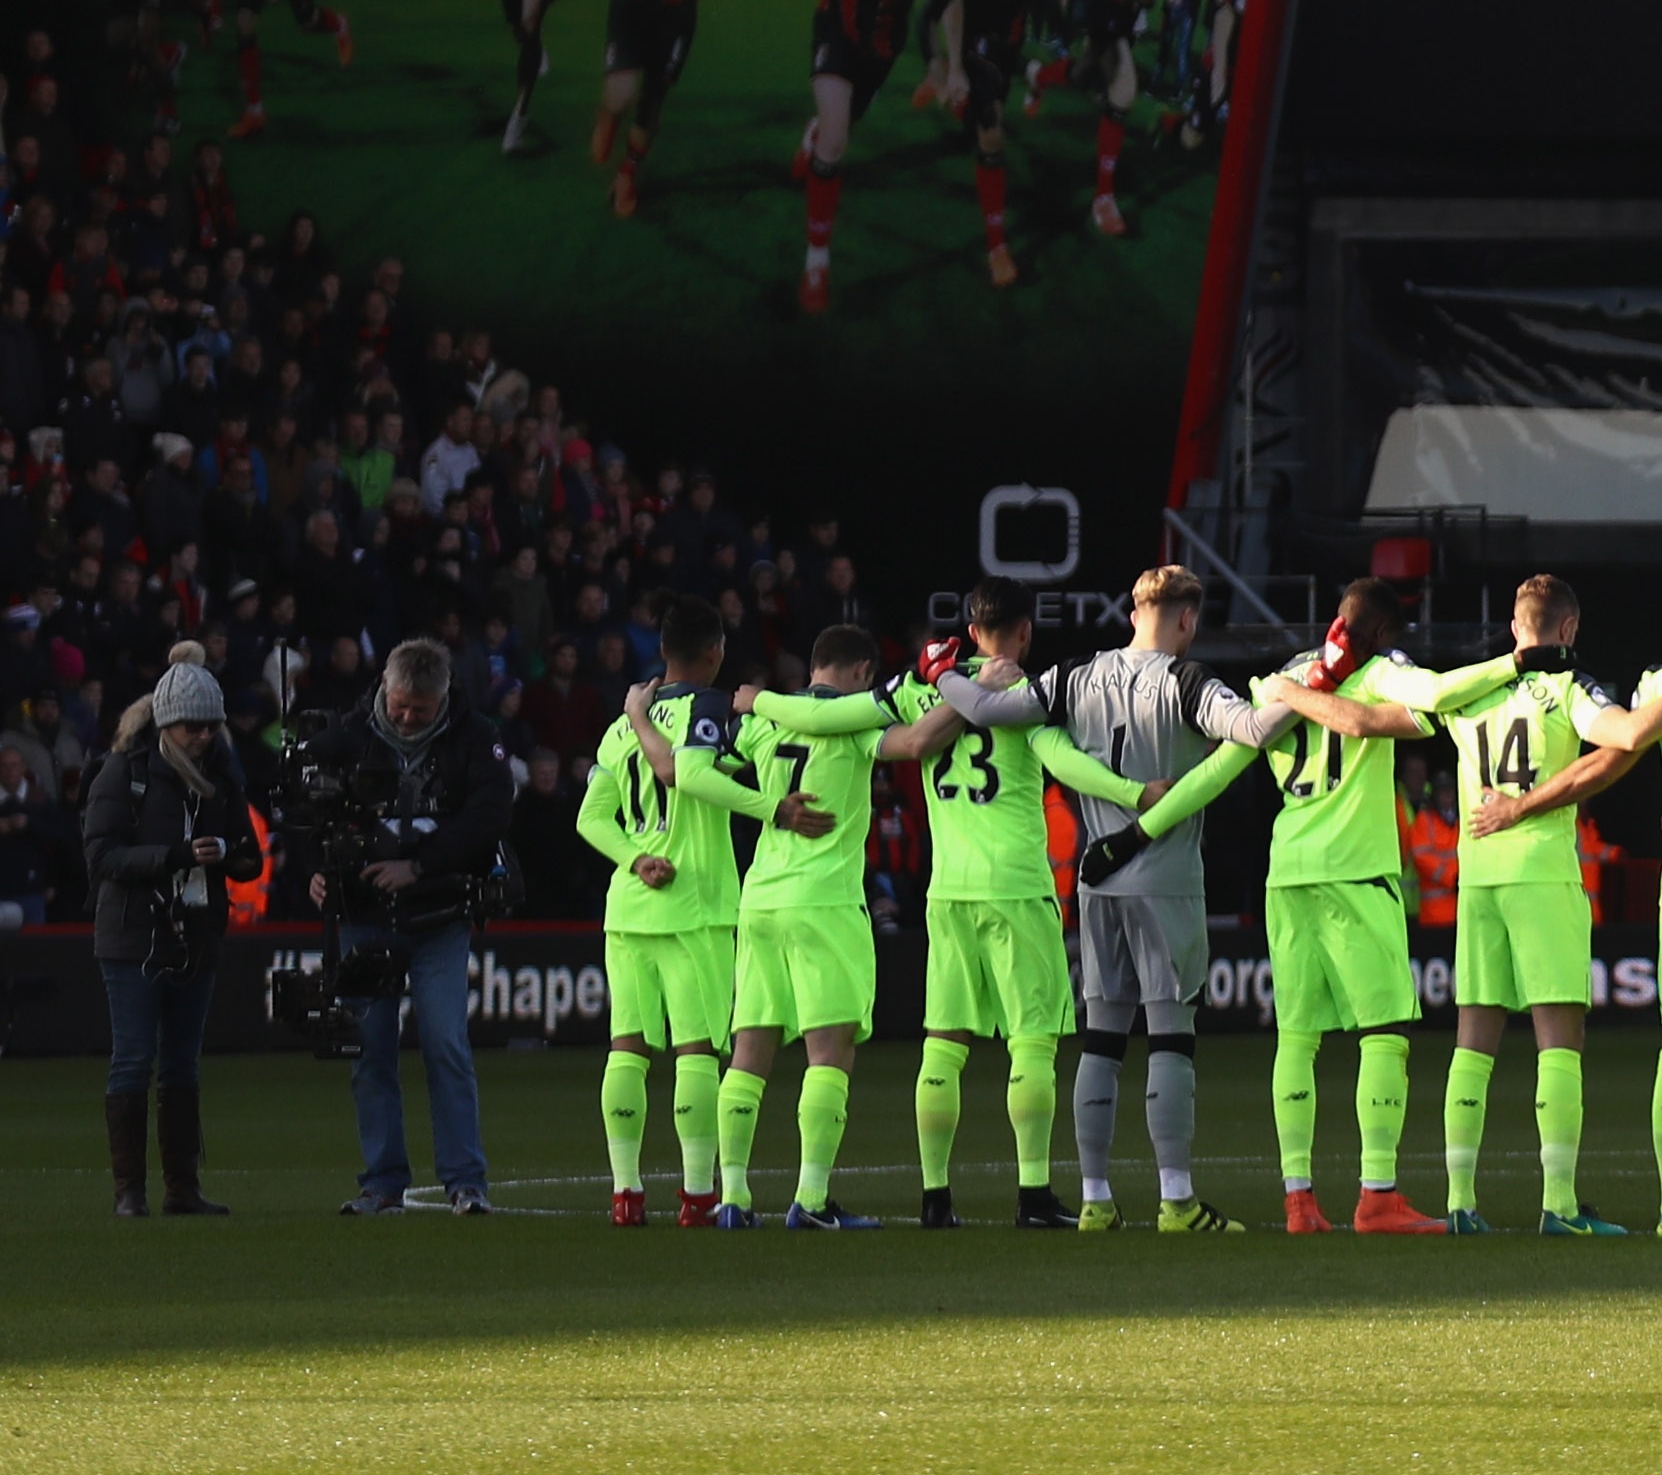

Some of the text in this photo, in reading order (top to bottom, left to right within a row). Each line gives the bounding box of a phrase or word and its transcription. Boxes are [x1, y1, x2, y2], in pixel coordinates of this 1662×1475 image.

[927, 591, 1131, 629] CETX
[775, 743, 811, 826] 7
[933, 722, 999, 805] 23
[1476, 717, 1539, 799] 14
